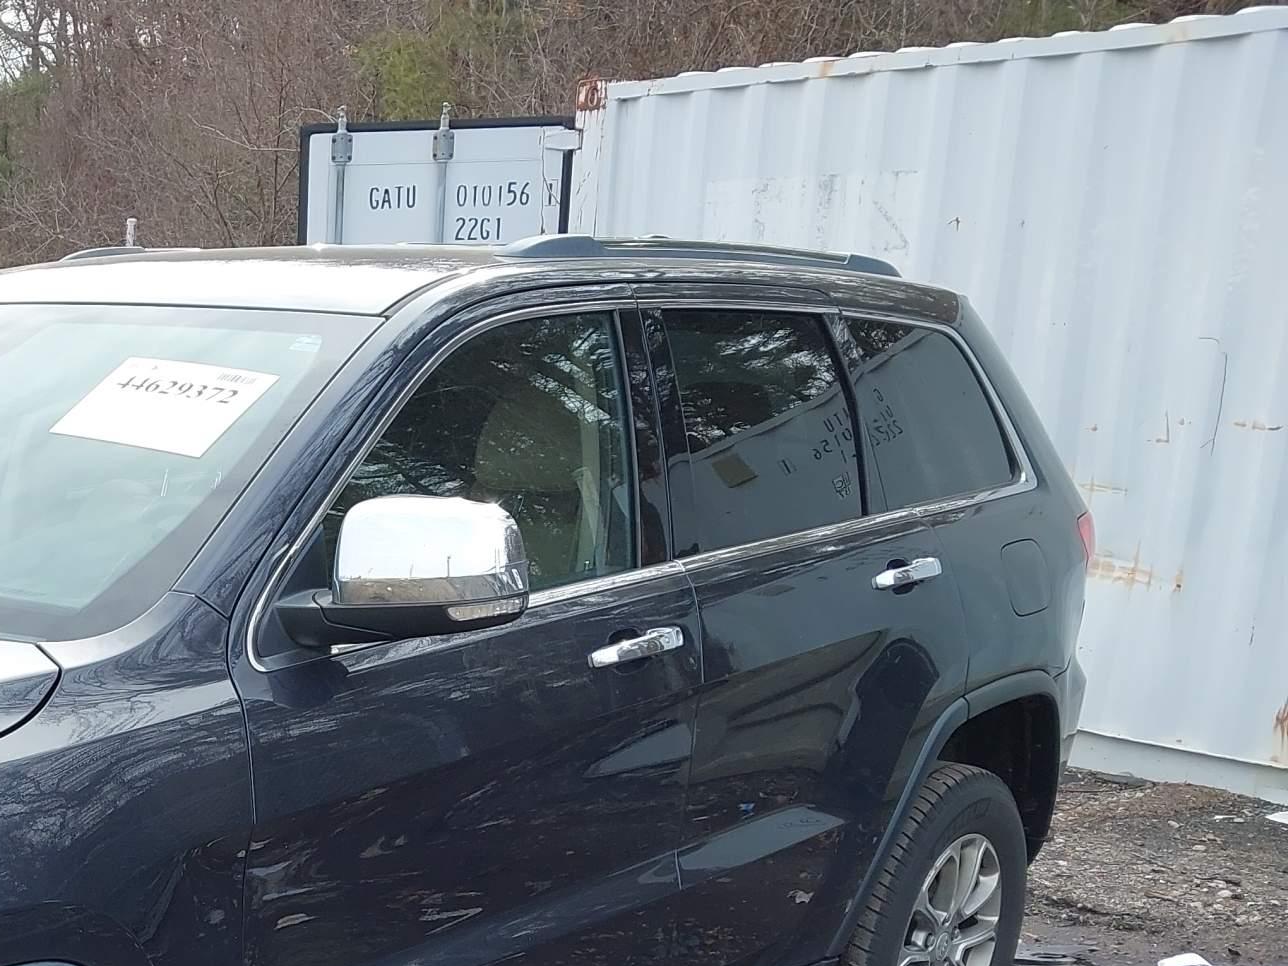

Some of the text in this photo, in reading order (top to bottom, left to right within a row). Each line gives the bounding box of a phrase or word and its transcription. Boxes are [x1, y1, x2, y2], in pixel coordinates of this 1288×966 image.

[369, 185, 417, 210] GATU
[456, 182, 530, 207] 010156
[455, 217, 501, 241] 22G1
[117, 376, 239, 404] 44629372
